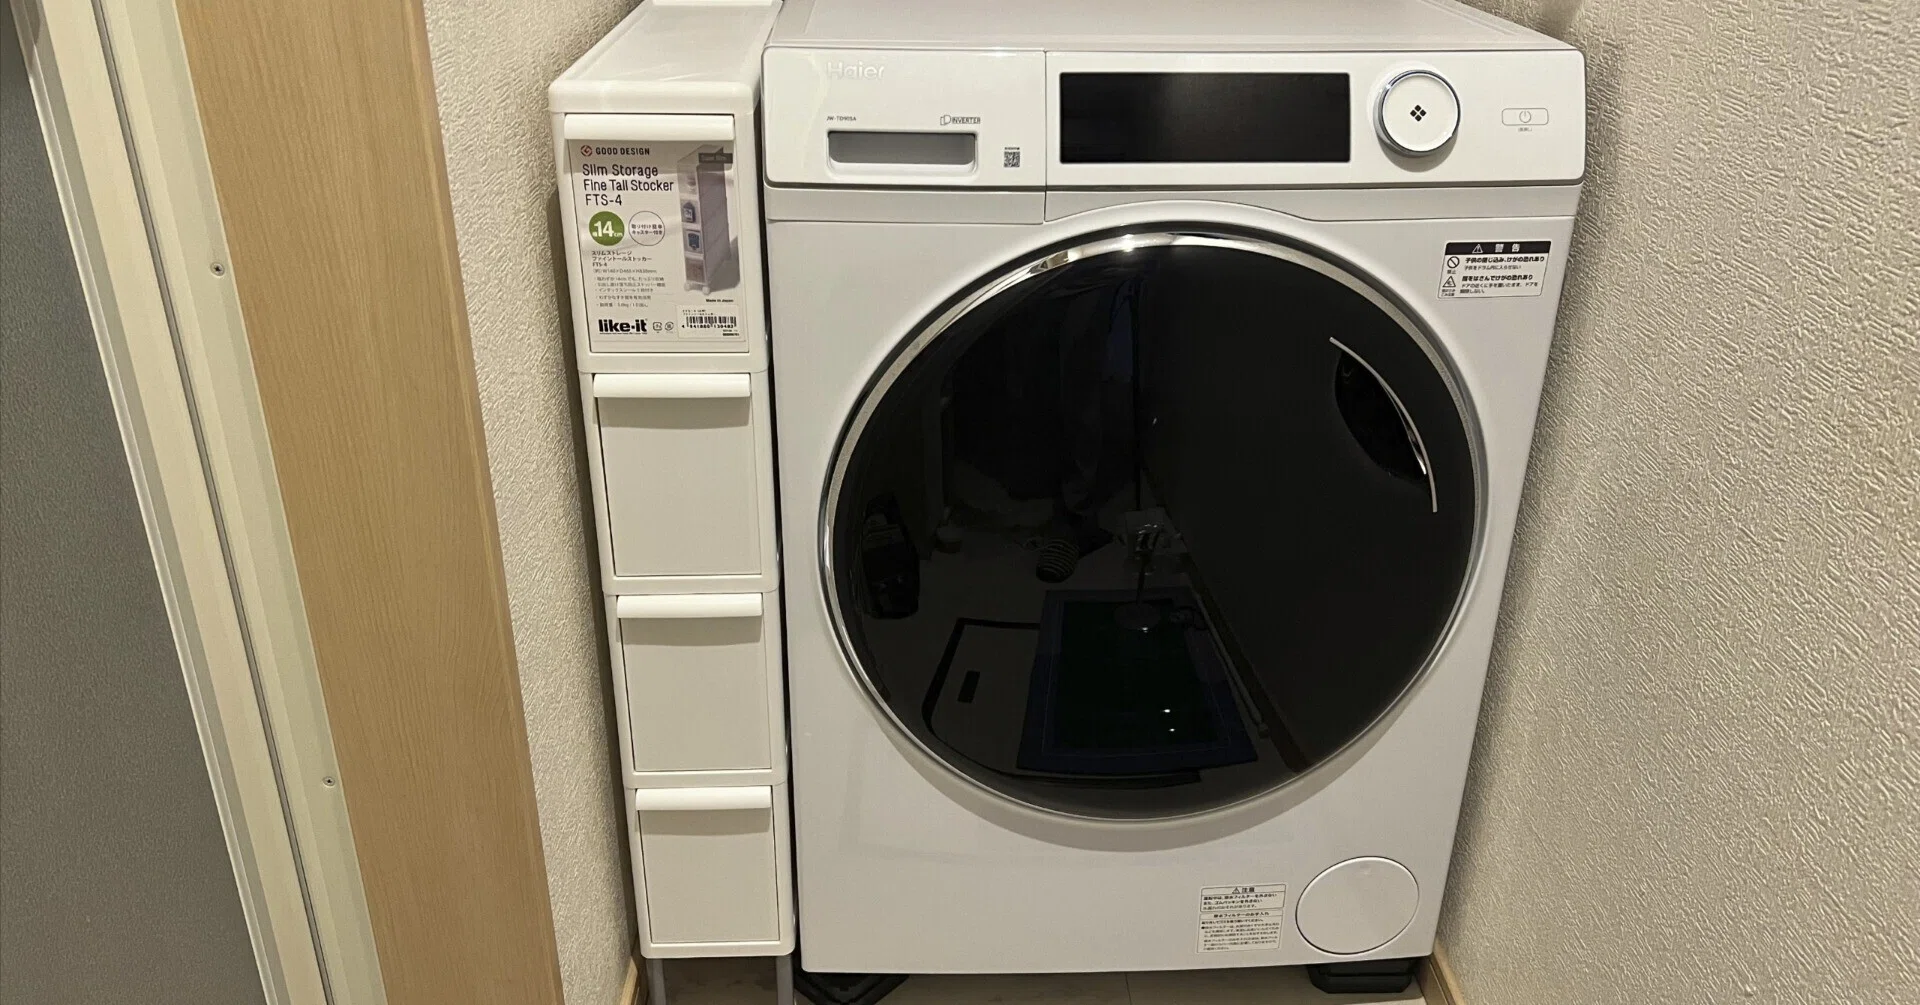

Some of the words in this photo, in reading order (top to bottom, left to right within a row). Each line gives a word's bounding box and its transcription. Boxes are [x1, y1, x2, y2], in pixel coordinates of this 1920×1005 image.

[827, 61, 884, 80] Haier
[596, 147, 618, 155] GOOD
[620, 147, 650, 155] DESIGN
[582, 164, 608, 176] Slim
[612, 164, 658, 178] Storage
[583, 179, 607, 191] Fine
[611, 179, 629, 191] Tall
[631, 179, 674, 191] Stocker
[585, 194, 623, 206] FTS-4
